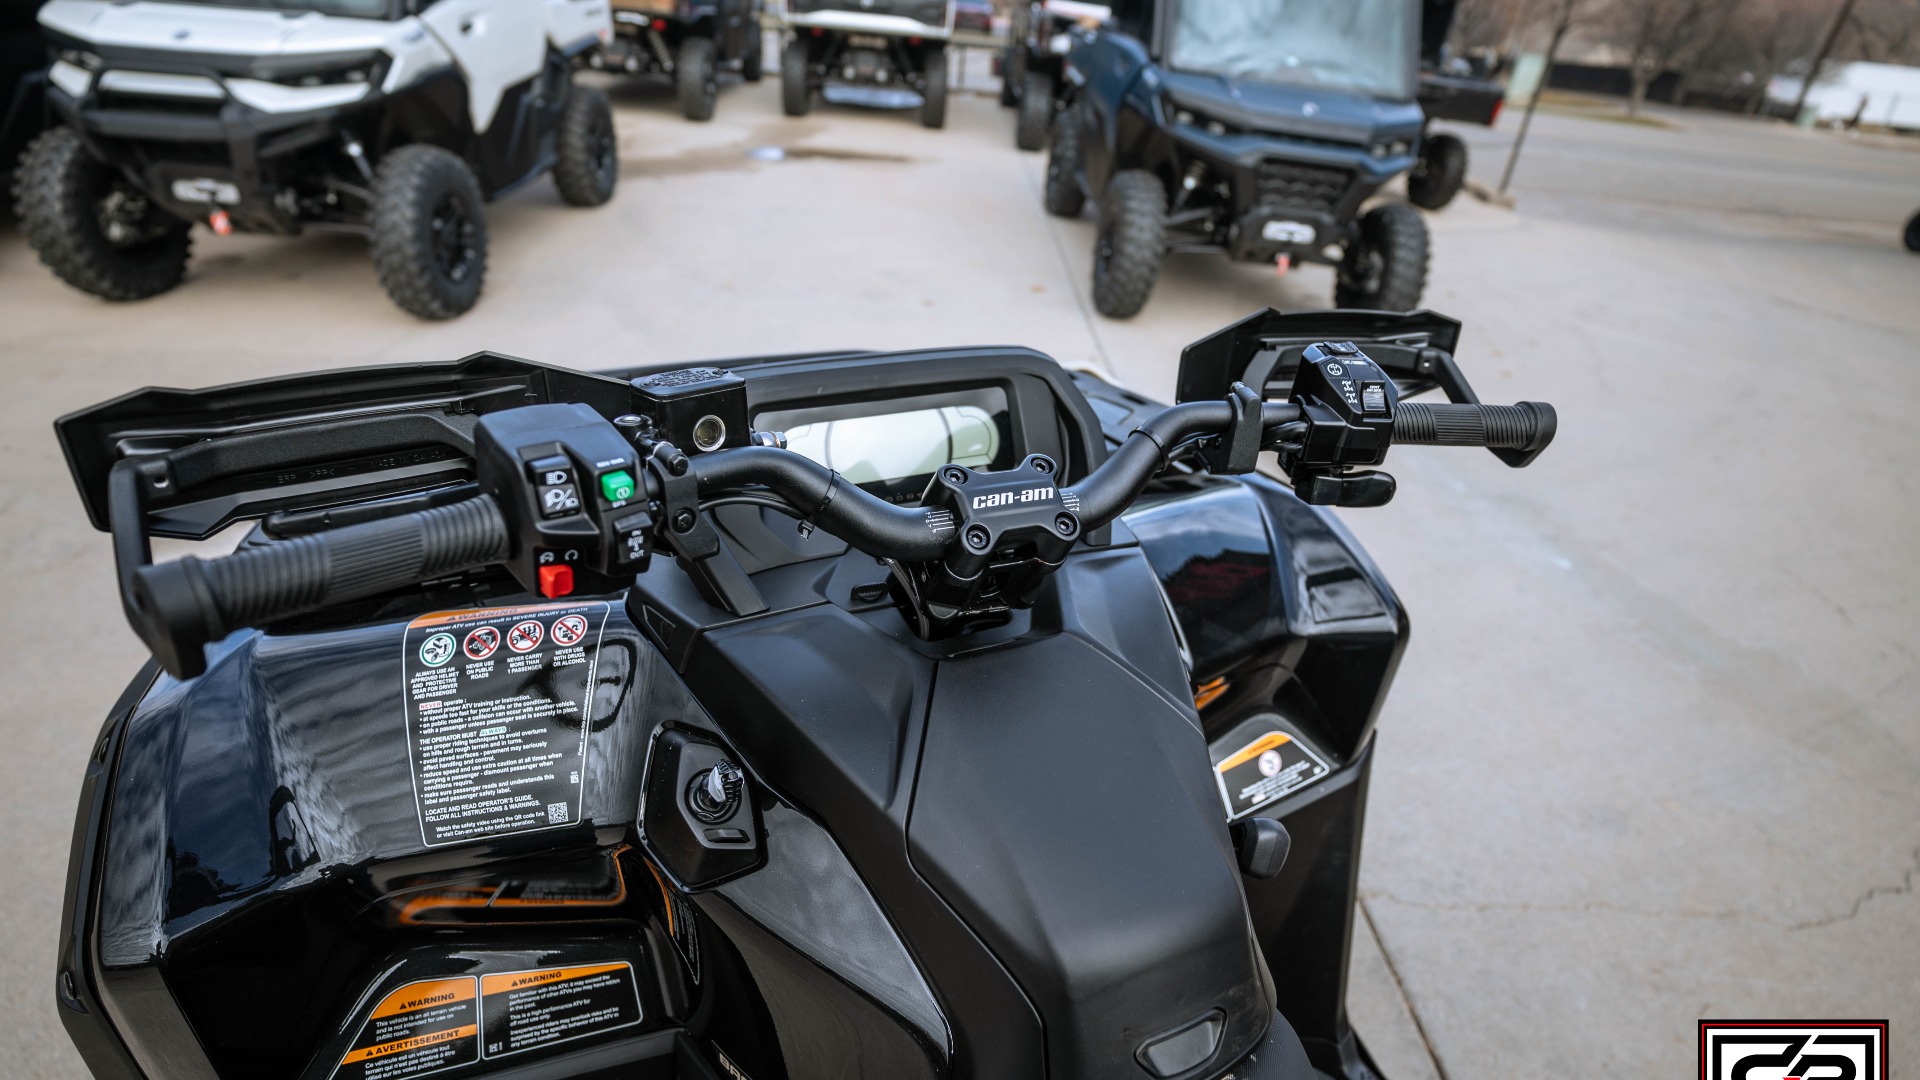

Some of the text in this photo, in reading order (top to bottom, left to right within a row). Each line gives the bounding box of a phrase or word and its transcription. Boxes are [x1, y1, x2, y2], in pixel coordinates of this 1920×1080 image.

[972, 487, 1053, 510] can-am
[459, 609, 518, 620] WARNING
[512, 664, 542, 673] PASSENGER
[411, 675, 438, 684] APPROVED
[426, 678, 457, 686] PROTECTIVE
[426, 689, 456, 698] PASSENGER
[431, 734, 460, 743] OPERATOR
[426, 808, 447, 816] LOCATE
[478, 797, 513, 807] OPERATOR'S
[426, 814, 449, 822] FOLLOW
[462, 806, 503, 817] INSTRUCTIONS
[509, 800, 540, 810] WARNINGS.
[519, 972, 562, 985] WARNING
[408, 993, 454, 1008] WARNING
[376, 1030, 460, 1054] AVERTISSEMENT
[719, 1053, 747, 1080] BR
